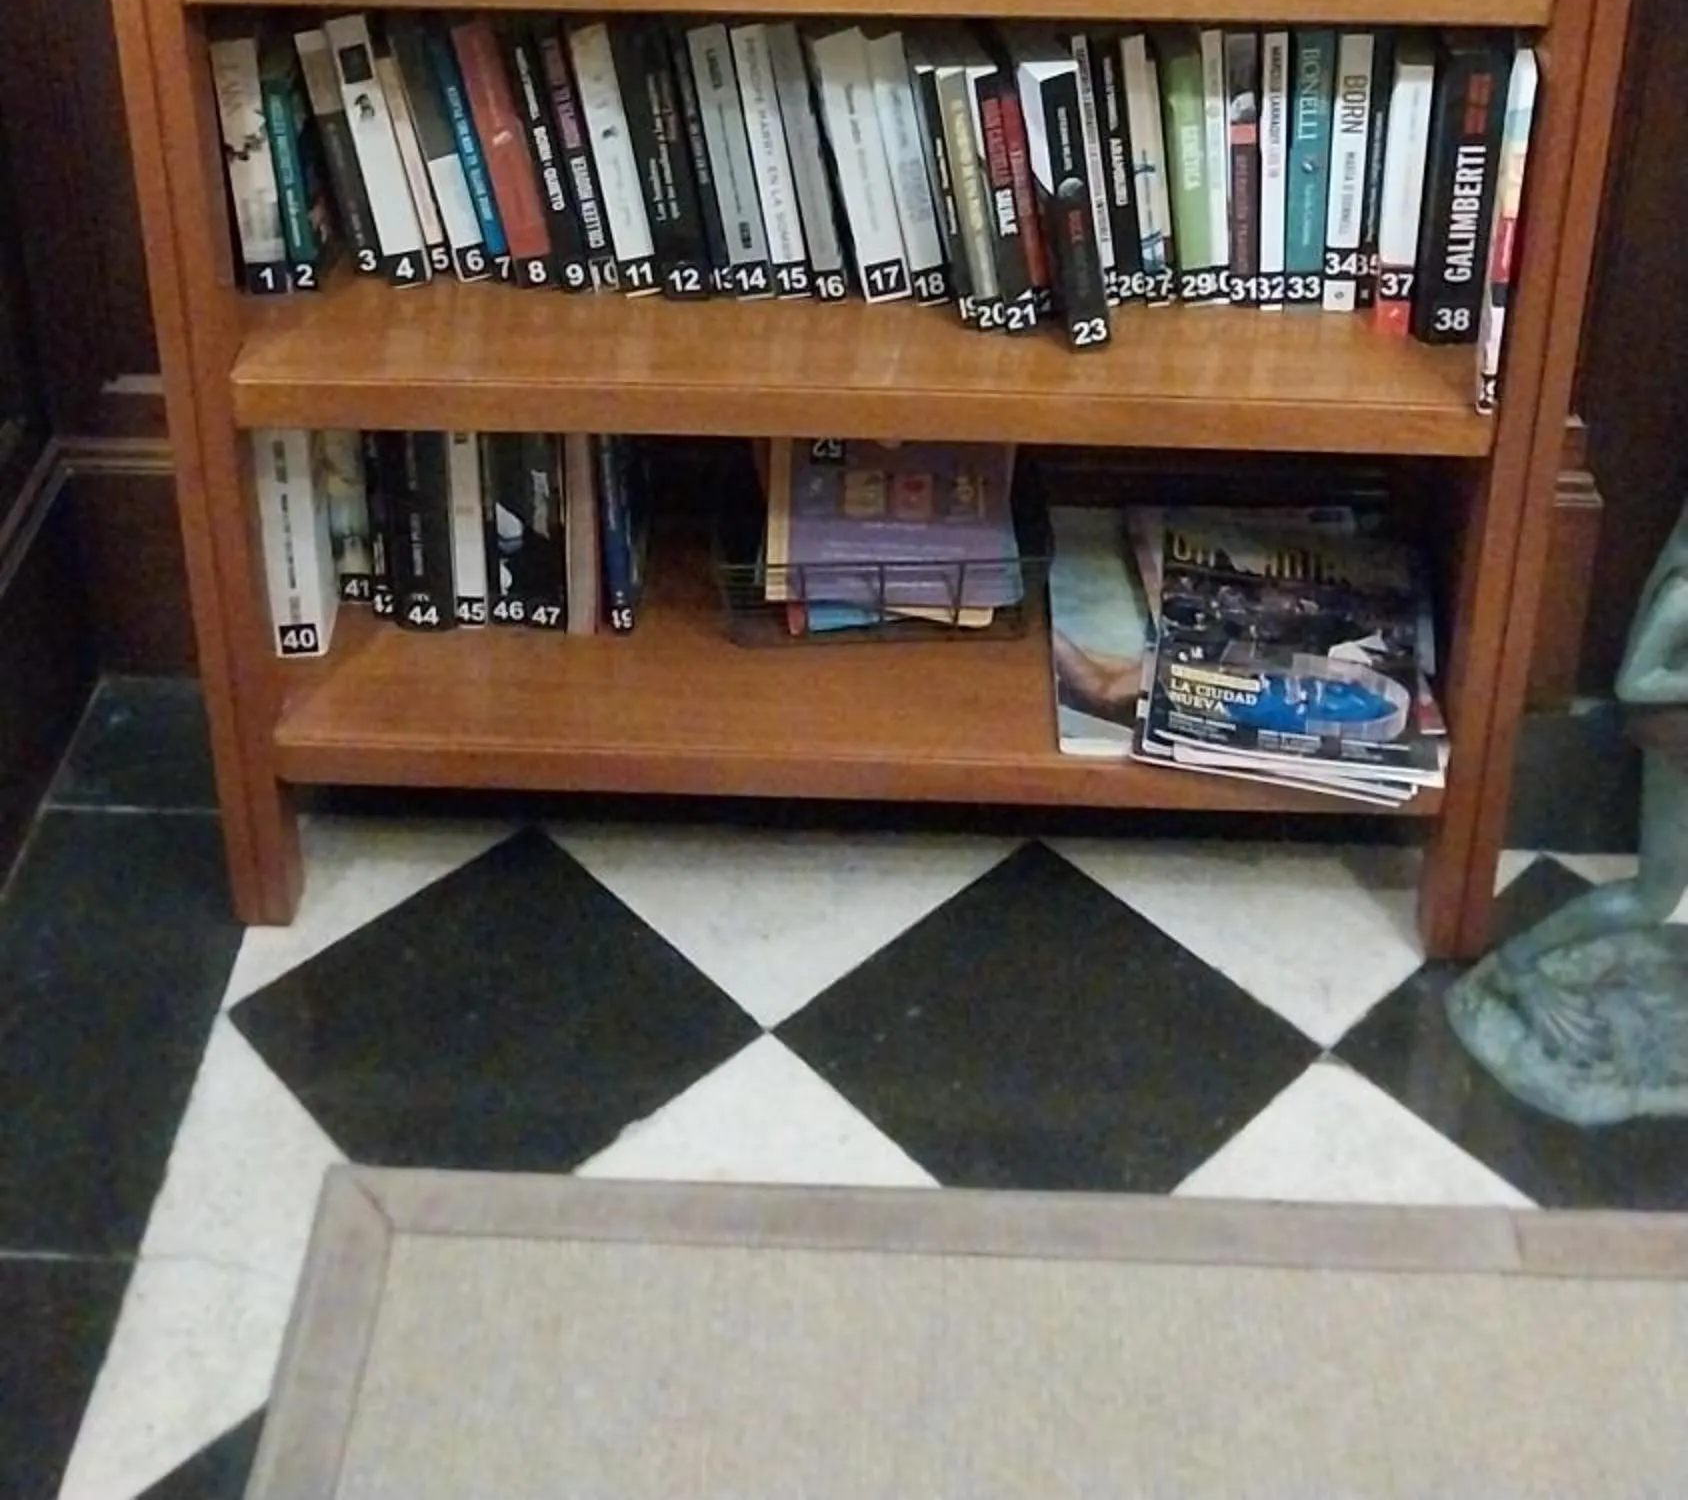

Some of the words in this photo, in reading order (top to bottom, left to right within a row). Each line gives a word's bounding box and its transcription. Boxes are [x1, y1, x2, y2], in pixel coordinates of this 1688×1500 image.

[1298, 48, 1321, 140] BONELLI
[1341, 75, 1369, 134] BORN
[1444, 145, 1487, 283] GALIMBERTI
[358, 249, 377, 271] 3
[396, 257, 414, 279] 4
[431, 247, 449, 269] 5
[465, 250, 484, 271] 6
[494, 256, 511, 279] 7
[1325, 252, 1357, 275] 34
[259, 267, 274, 289] 1
[295, 263, 315, 287] 2
[528, 260, 546, 282] 8
[565, 263, 584, 286] 9
[626, 262, 653, 287] 11
[668, 268, 700, 292] 12
[735, 267, 766, 291] 14
[777, 266, 808, 290] 15
[870, 265, 899, 291] 17
[815, 275, 844, 298] 16
[914, 272, 945, 298] 18
[1119, 271, 1145, 297] 26
[1182, 273, 1211, 297] 29
[1230, 277, 1257, 300] 31
[1287, 276, 1321, 299] 33
[1381, 273, 1414, 296] 37
[978, 303, 1005, 328] 20
[1006, 303, 1037, 329] 21
[1435, 307, 1470, 331] 38
[1072, 318, 1107, 345] 23
[345, 579, 369, 597] 41
[408, 606, 439, 625] 44
[457, 602, 485, 621] 45
[493, 602, 524, 620] 46
[532, 606, 560, 626] 47
[283, 628, 315, 649] 40
[1169, 691, 1226, 713] NUEVA
[1171, 678, 1191, 693] LA
[1195, 685, 1258, 706] CIUDAD
